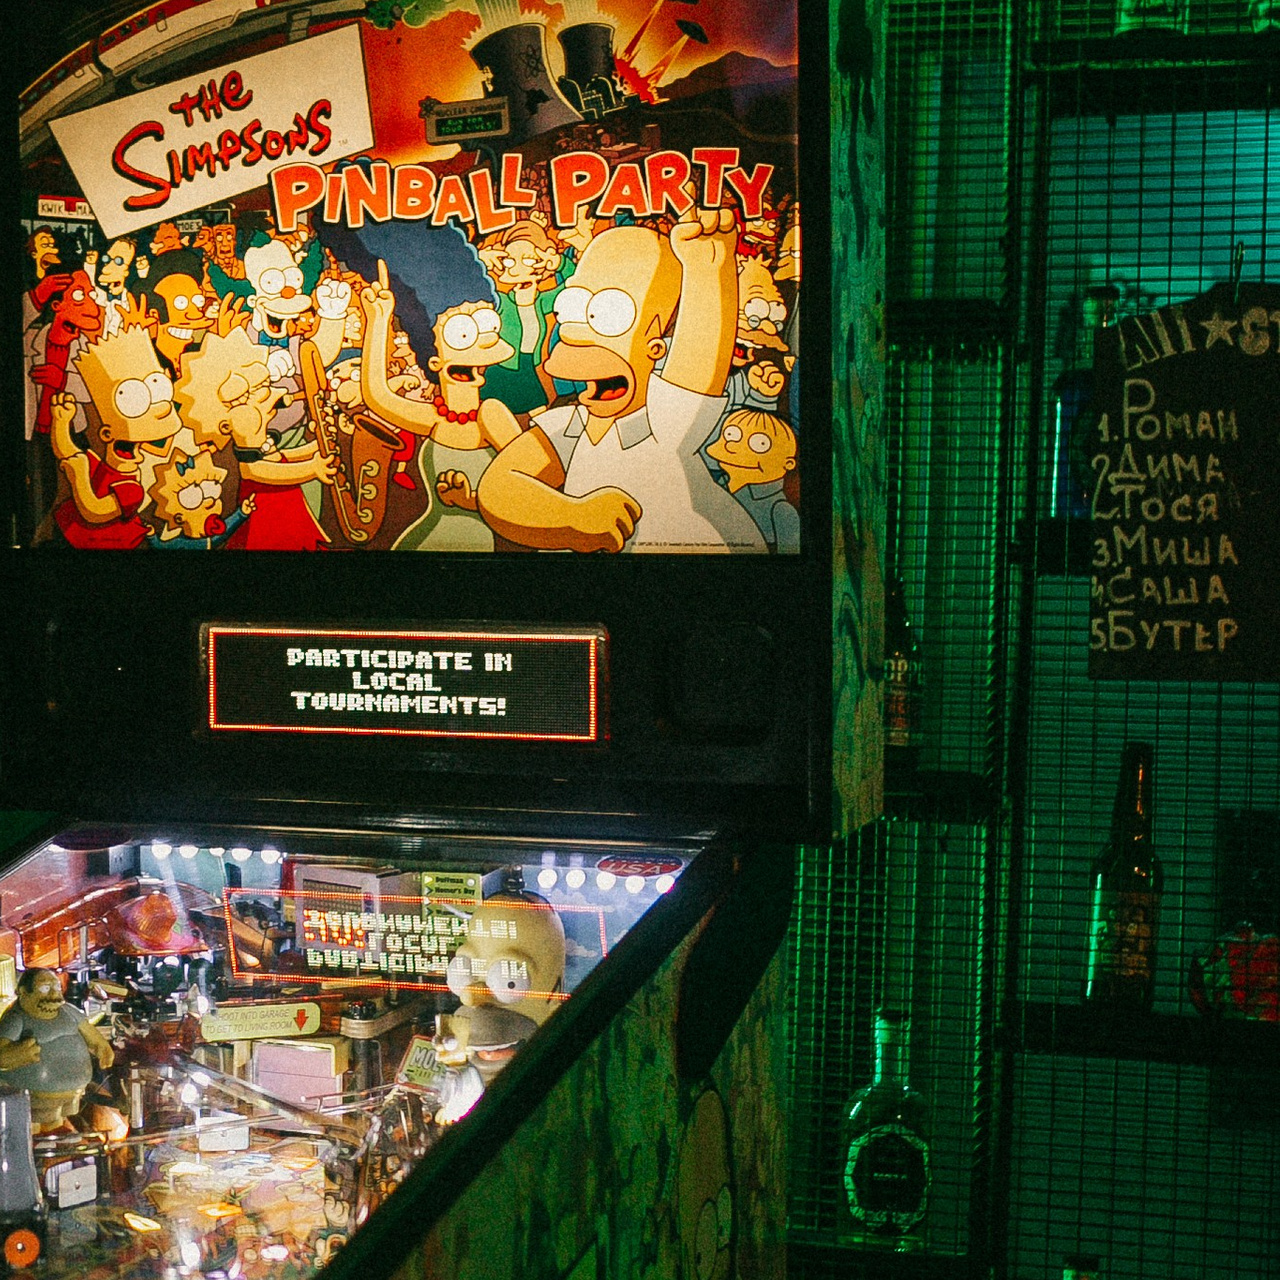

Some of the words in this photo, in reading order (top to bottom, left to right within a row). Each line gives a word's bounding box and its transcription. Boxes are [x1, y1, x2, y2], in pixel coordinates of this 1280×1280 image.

[112, 98, 332, 212] SIMPSONS
[270, 152, 538, 234] PINBALL
[550, 147, 774, 228] PARTY
[287, 647, 472, 672] PARTICIPATE
[485, 652, 513, 672] IN
[353, 671, 442, 693] LOCAL
[290, 690, 507, 717] TOURNAMENTS!
[605, 863, 662, 875] USA
[217, 1011, 240, 1022] HOOT
[260, 1008, 291, 1019] GARAGE
[270, 1019, 294, 1030] ROOM
